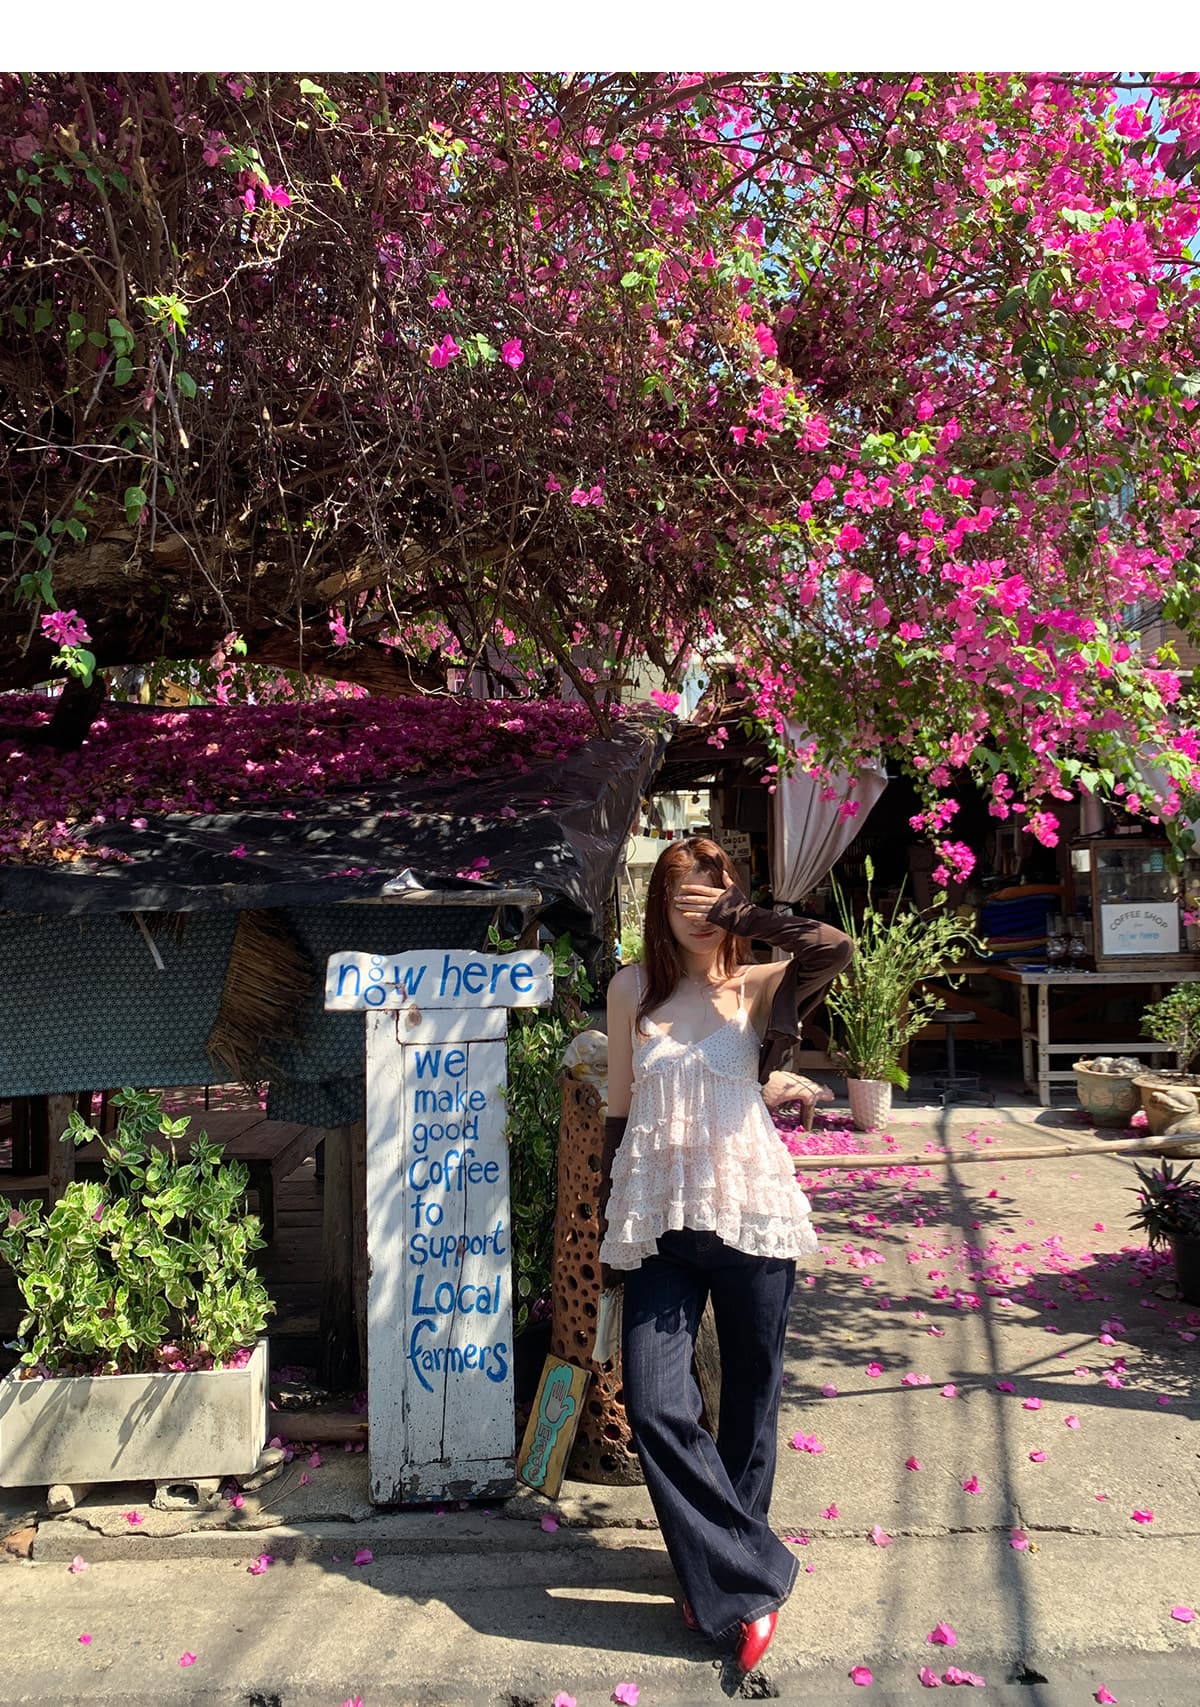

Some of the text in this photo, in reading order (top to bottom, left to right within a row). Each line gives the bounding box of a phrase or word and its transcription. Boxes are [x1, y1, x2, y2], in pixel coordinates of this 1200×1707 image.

[1110, 910, 1168, 931] COFFEE SHOP
[439, 954, 534, 997] here
[414, 1081, 487, 1114] make
[412, 1115, 479, 1154] good
[411, 1194, 444, 1228] to
[411, 1274, 502, 1316] Local
